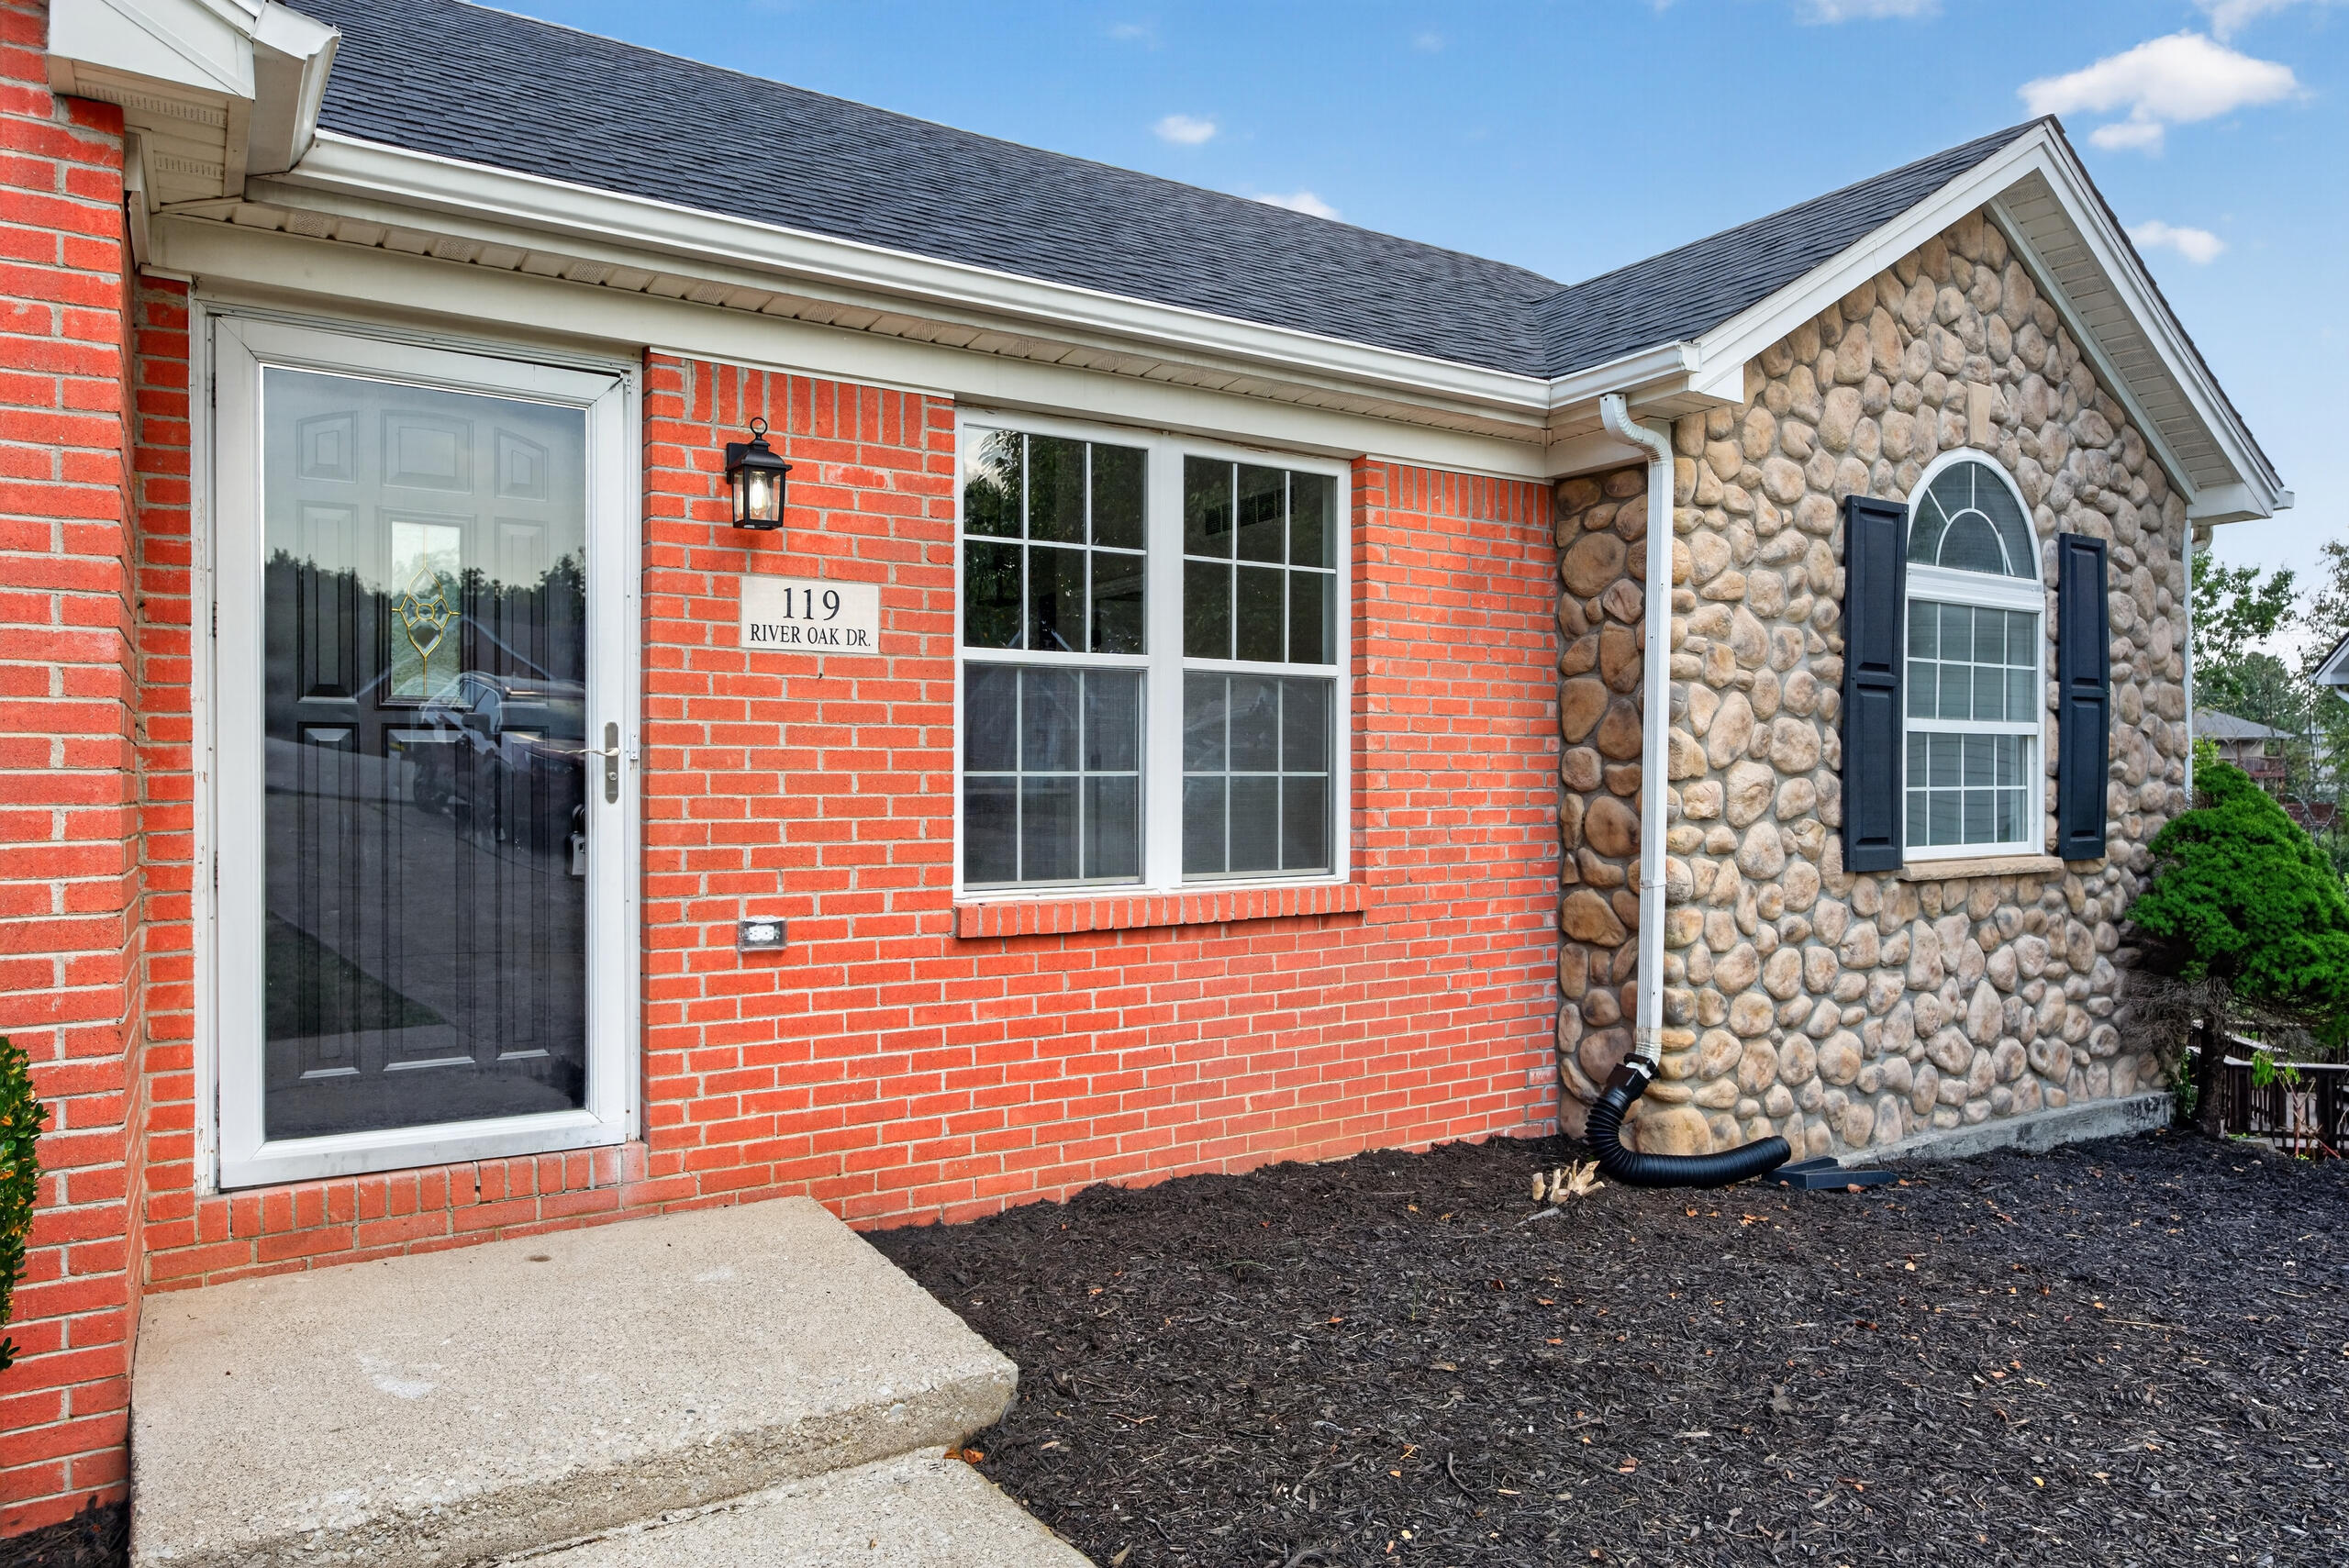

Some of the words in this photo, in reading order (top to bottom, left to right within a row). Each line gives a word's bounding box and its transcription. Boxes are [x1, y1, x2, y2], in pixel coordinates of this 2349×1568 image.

[783, 587, 841, 621] 119
[751, 624, 801, 643] RIVER
[807, 627, 840, 645] OAK
[846, 628, 871, 647] DR.
